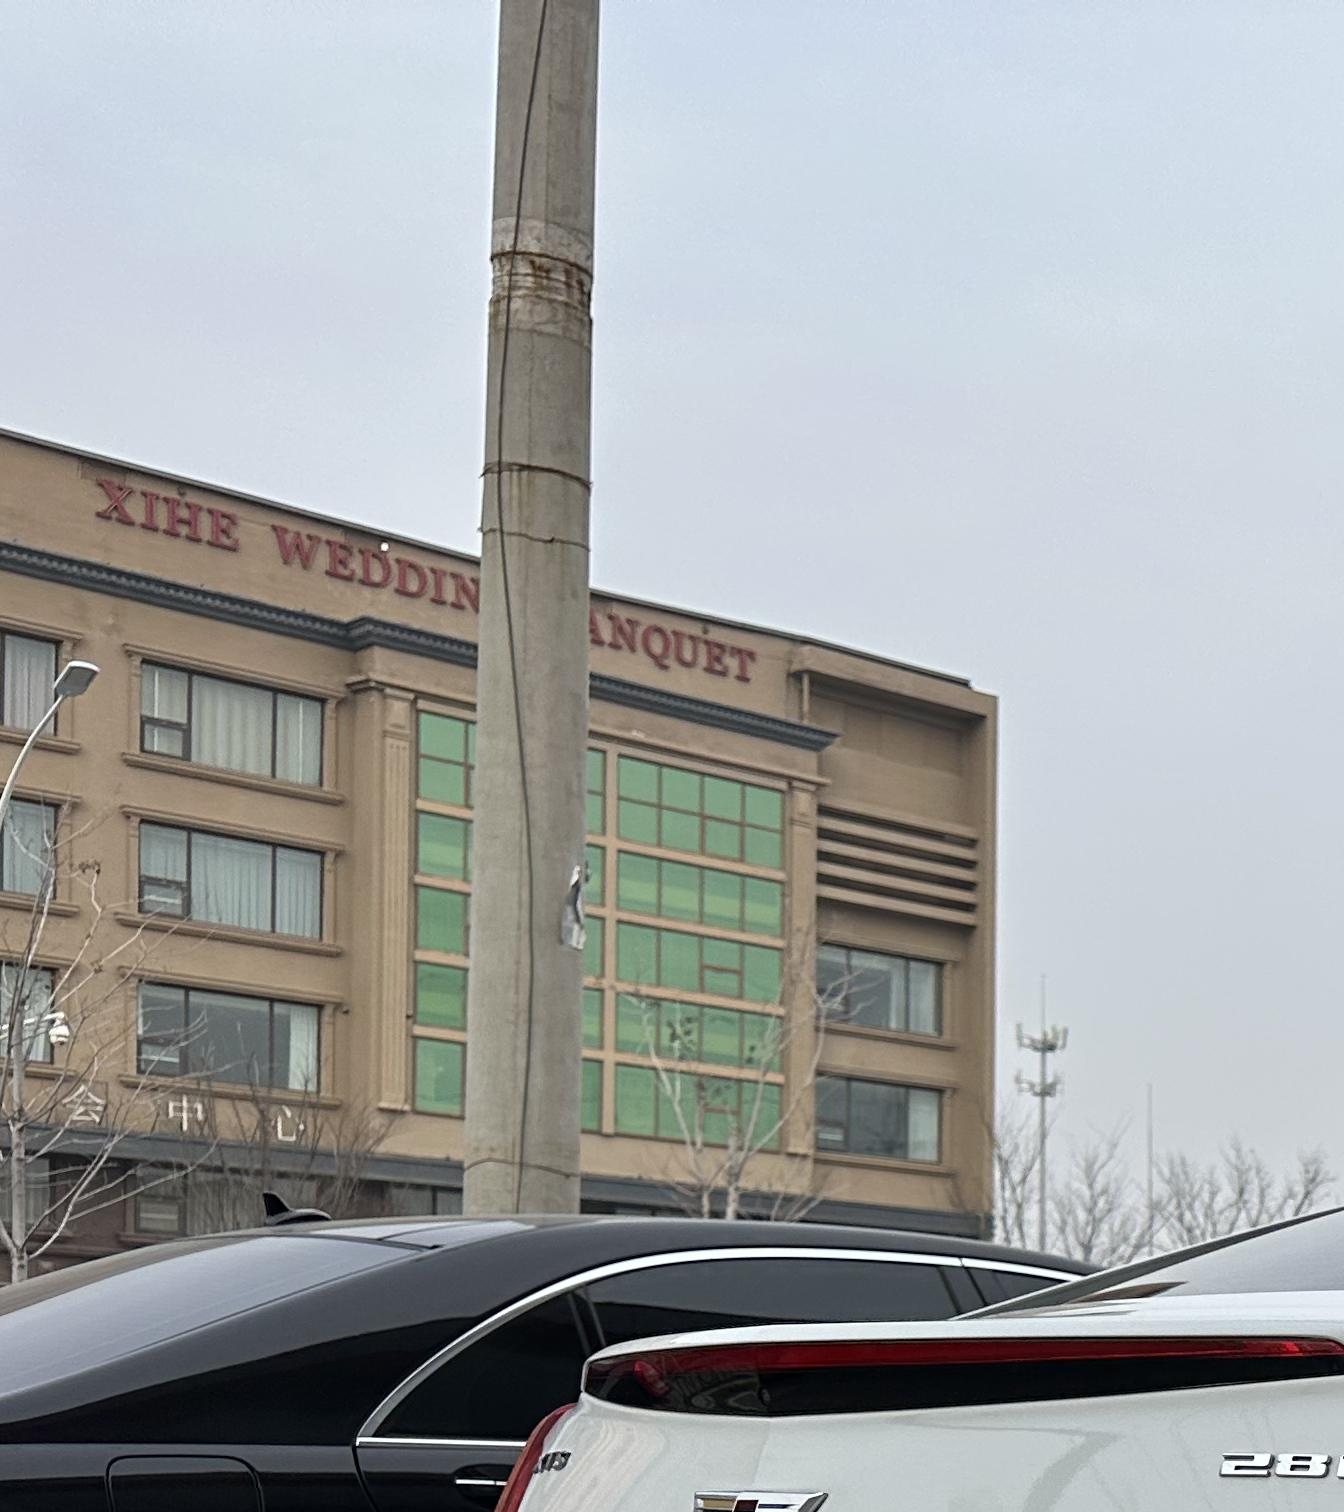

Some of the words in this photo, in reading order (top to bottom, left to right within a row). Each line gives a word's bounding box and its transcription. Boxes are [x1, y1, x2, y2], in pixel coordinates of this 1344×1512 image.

[96, 478, 240, 552] XIHE
[271, 524, 480, 614] WEDDIN
[589, 608, 757, 683] ANQUET
